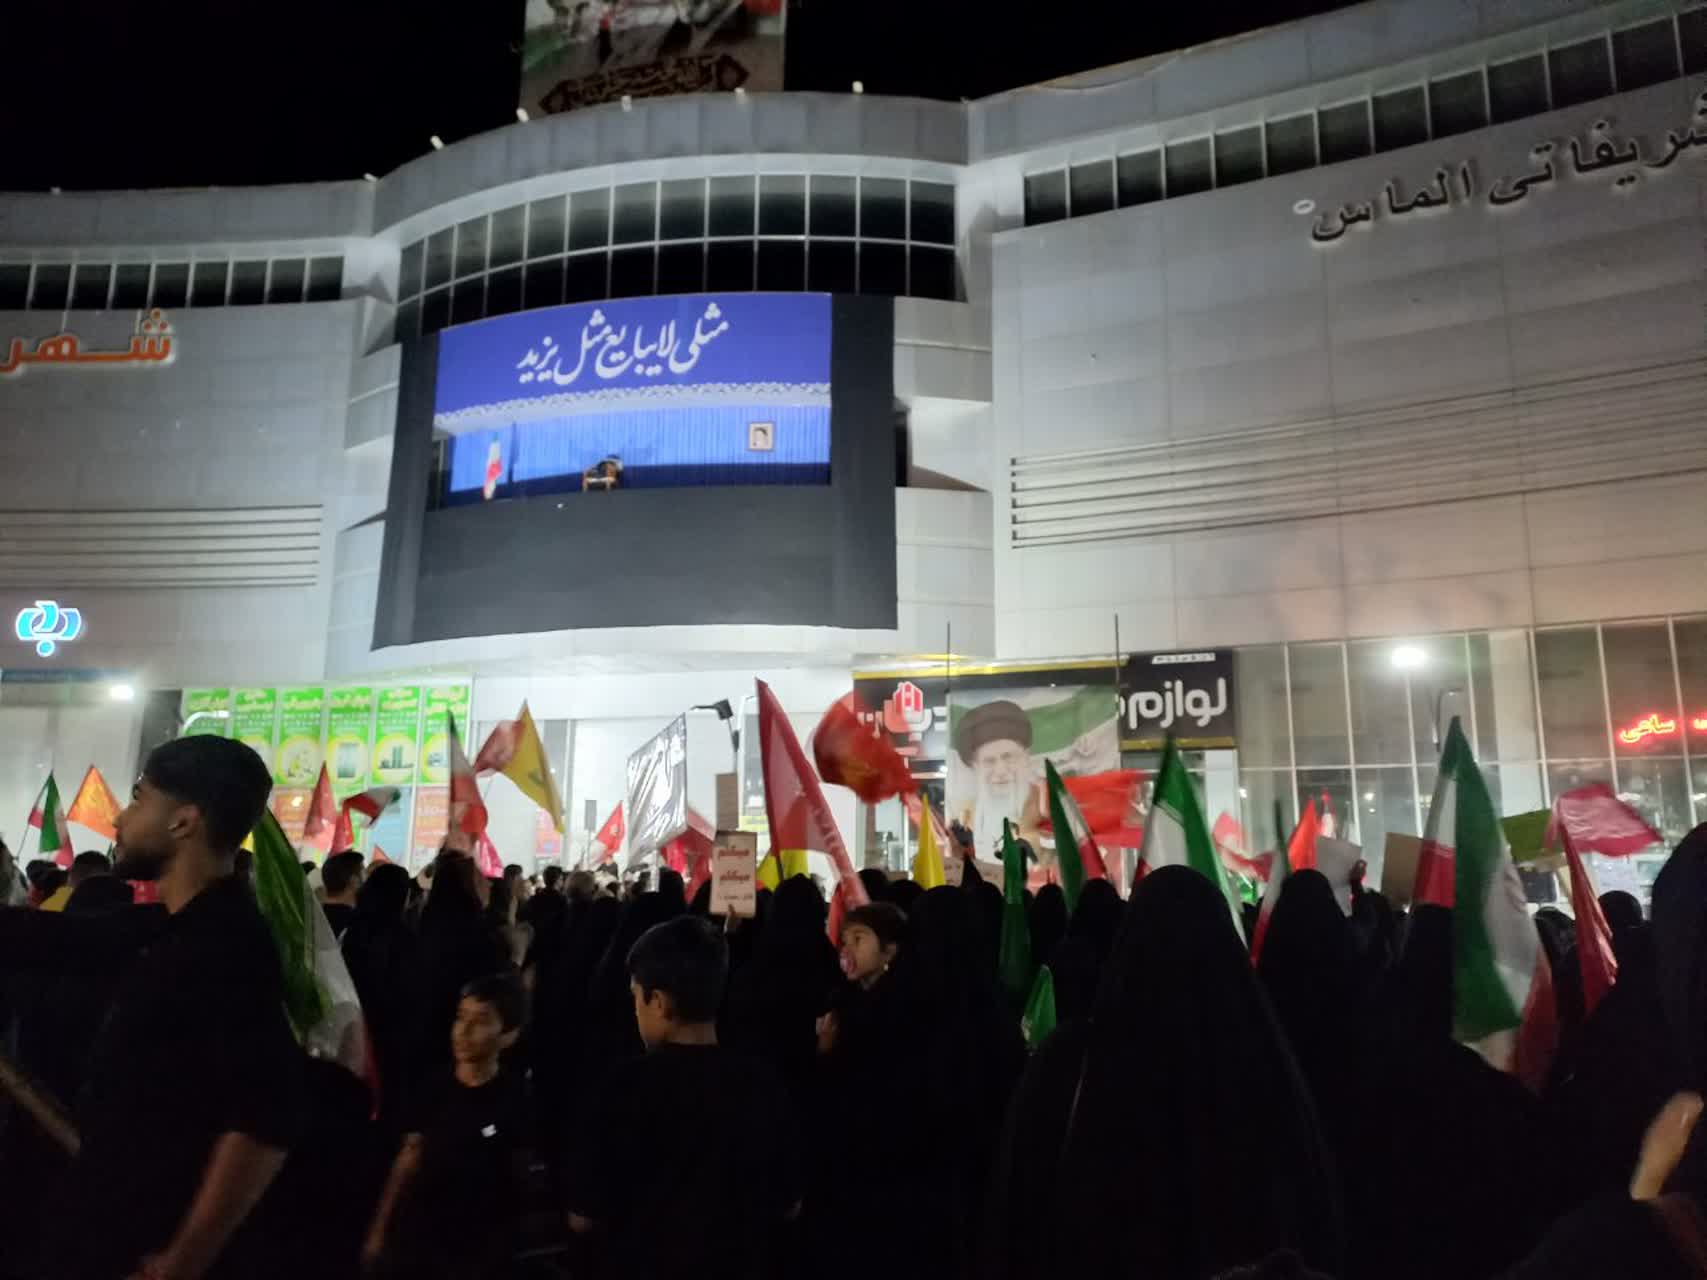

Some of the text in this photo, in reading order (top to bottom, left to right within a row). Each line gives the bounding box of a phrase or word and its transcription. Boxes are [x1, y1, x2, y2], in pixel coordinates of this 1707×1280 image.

[1310, 164, 1474, 242] الماس
[0, 308, 172, 374] شهر
[515, 336, 560, 384] یزید
[553, 308, 613, 386] مثل
[1128, 677, 1228, 731] لوازم
